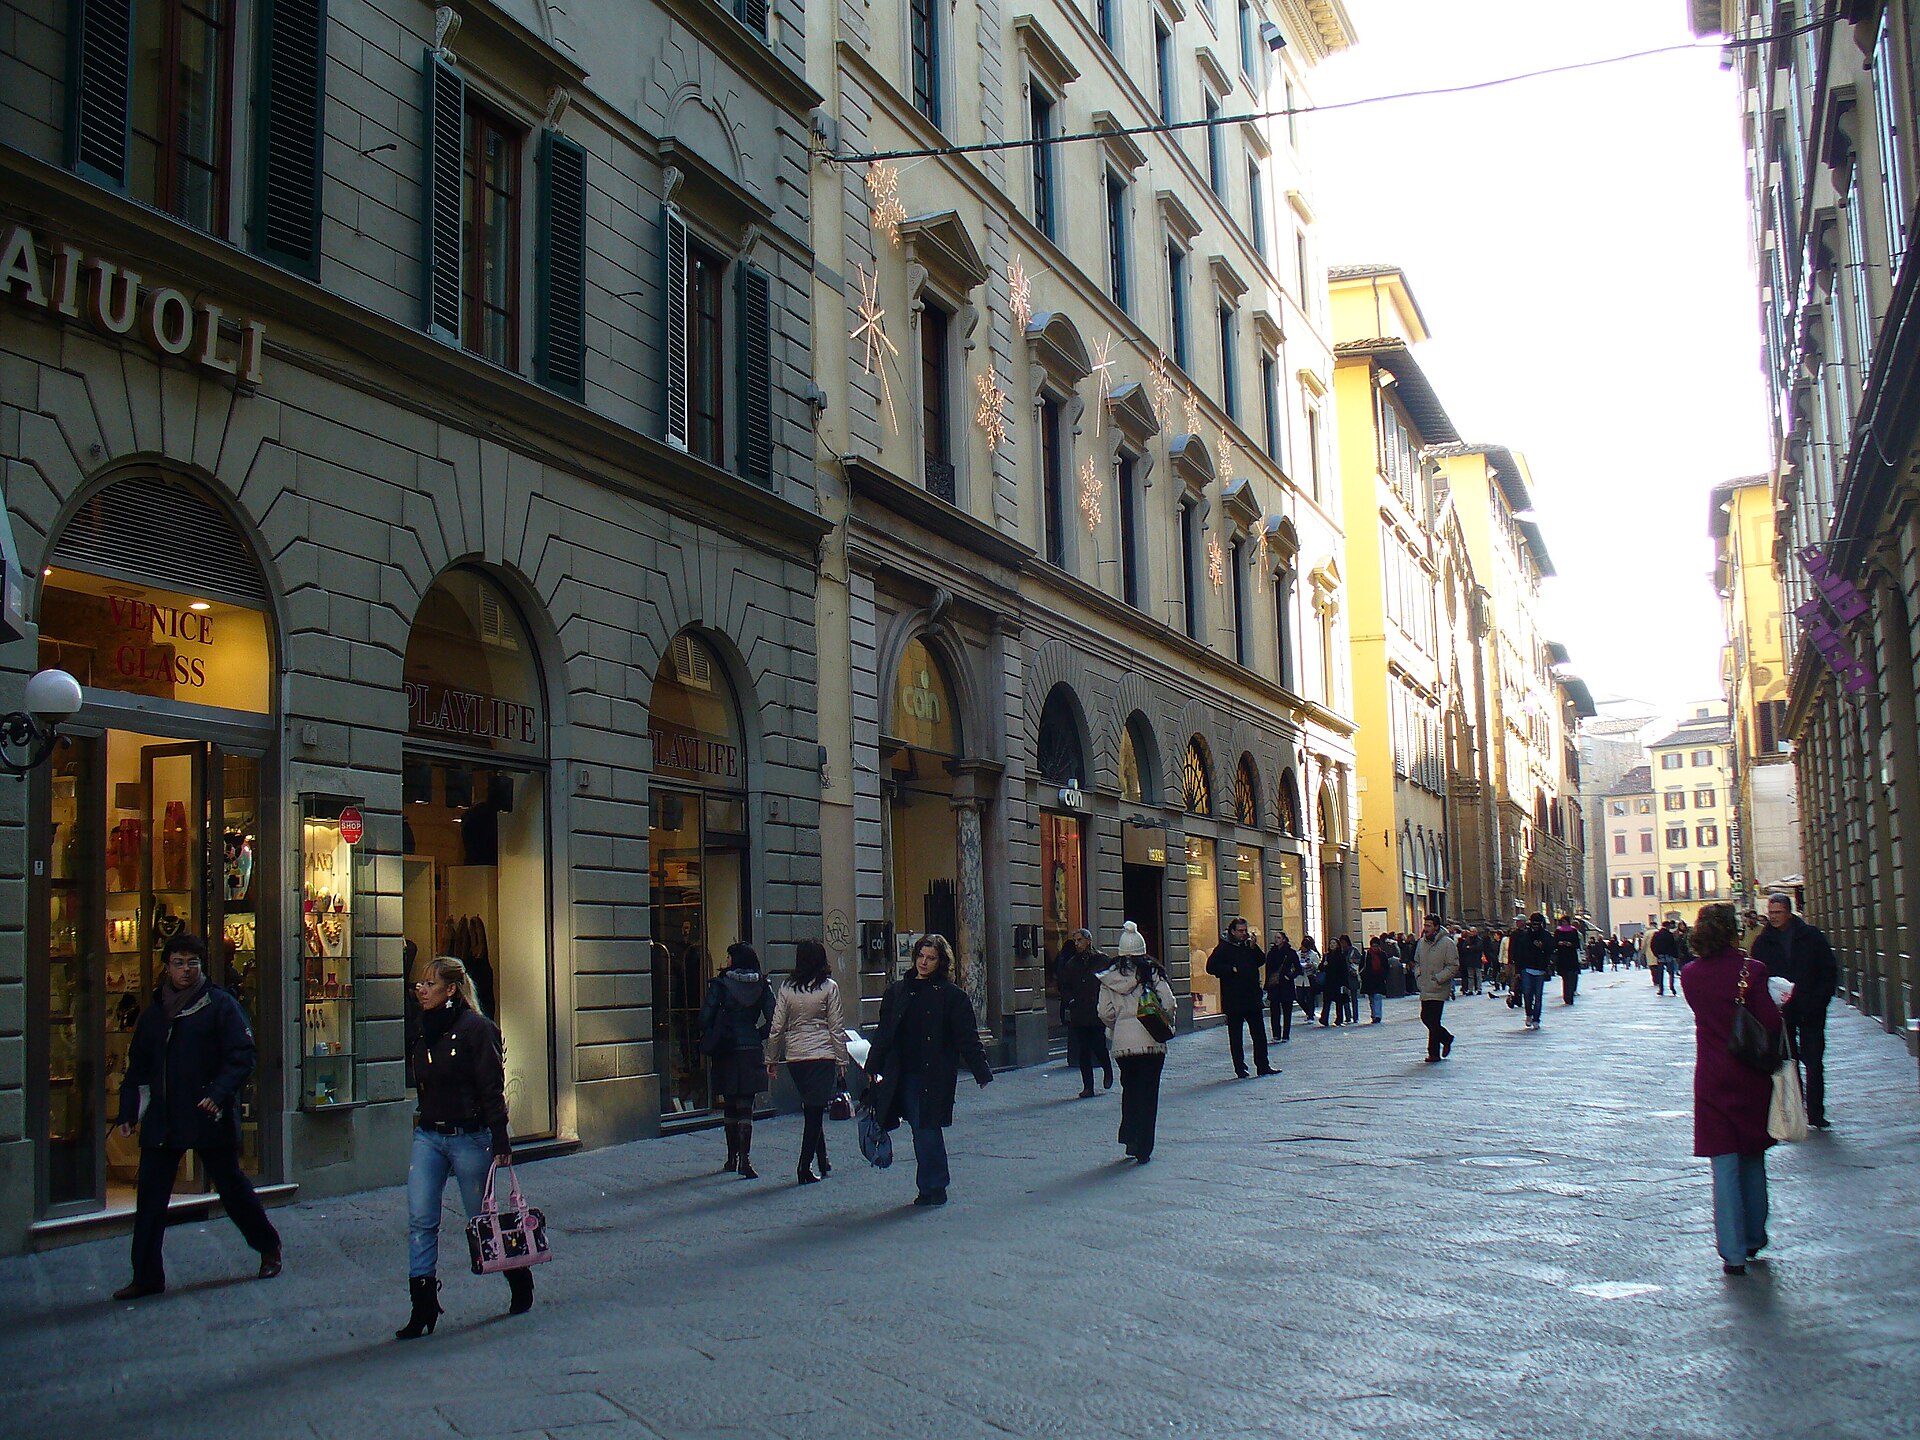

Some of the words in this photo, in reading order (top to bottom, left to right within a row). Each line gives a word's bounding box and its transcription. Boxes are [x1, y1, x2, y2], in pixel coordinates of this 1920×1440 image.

[109, 595, 214, 645] VENICE
[116, 645, 205, 687] GLASS
[341, 822, 362, 830] SHOP
